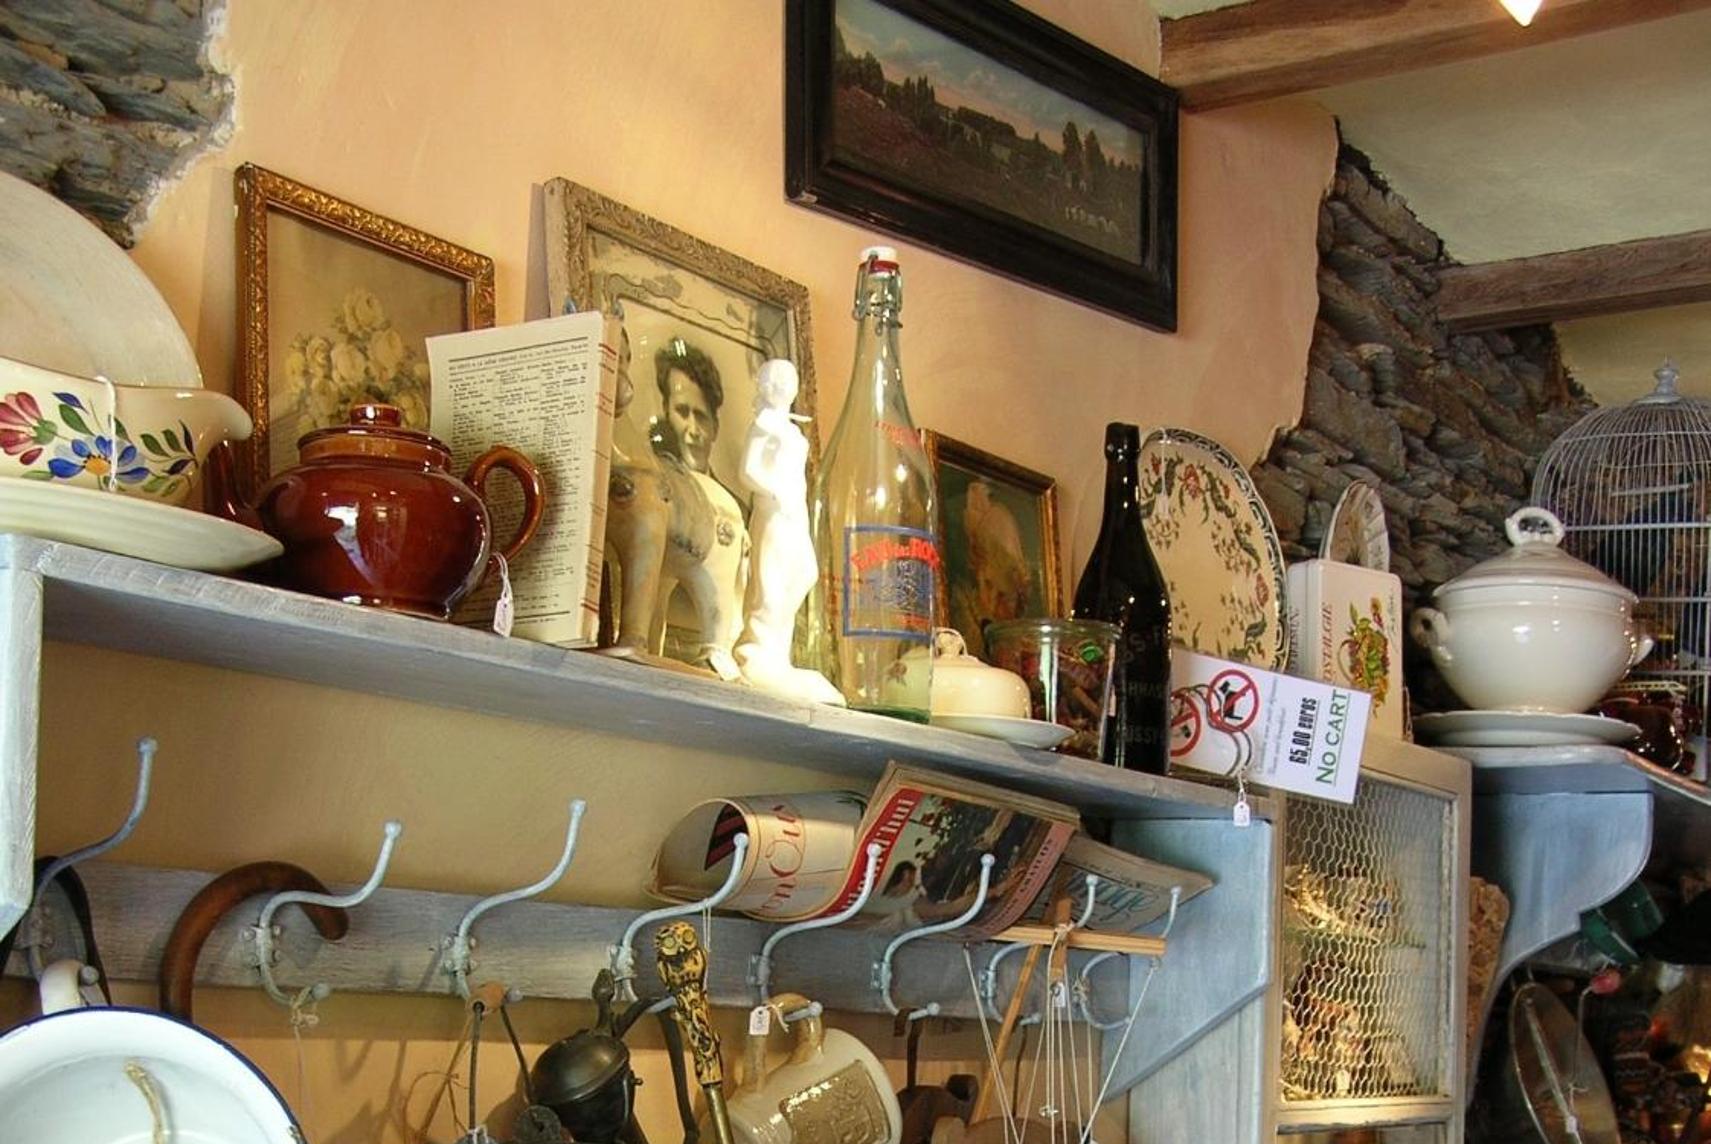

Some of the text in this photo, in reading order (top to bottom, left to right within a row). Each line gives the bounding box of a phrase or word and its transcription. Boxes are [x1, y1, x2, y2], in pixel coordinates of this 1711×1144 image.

[1289, 697, 1317, 765] 65,00 euros
[1325, 689, 1348, 746] CART
